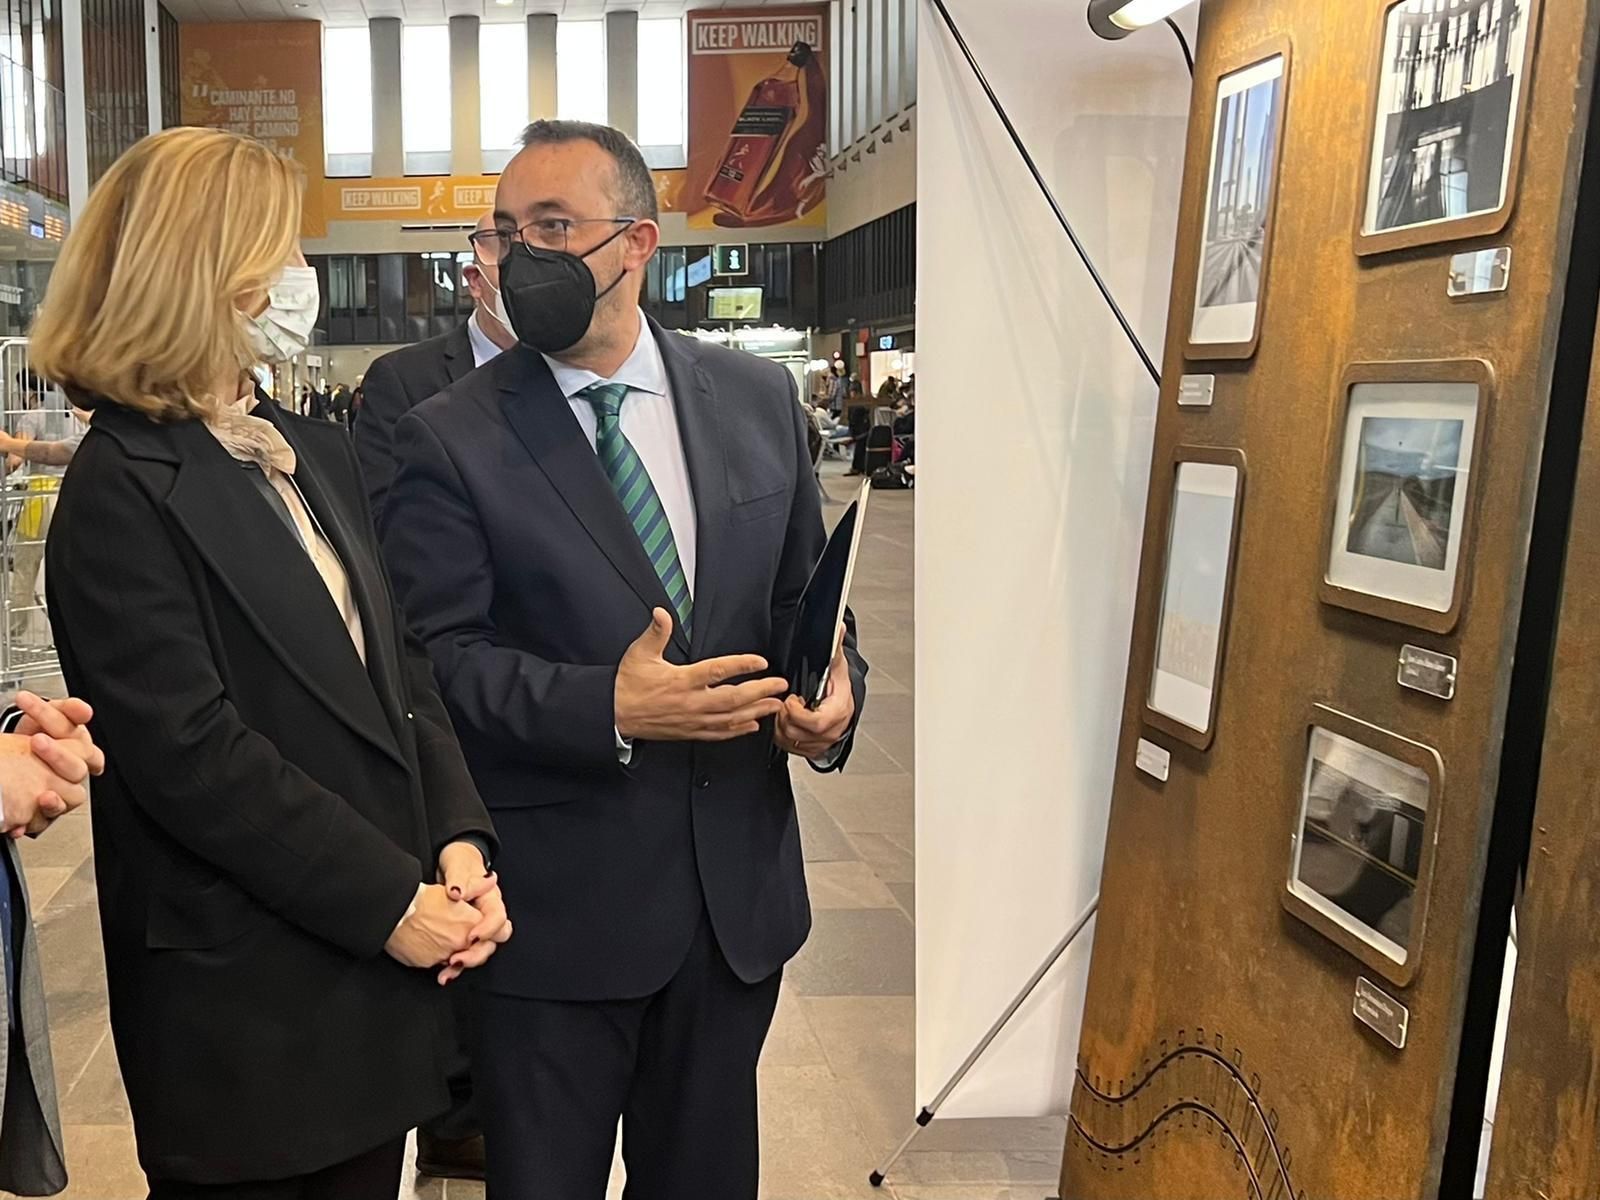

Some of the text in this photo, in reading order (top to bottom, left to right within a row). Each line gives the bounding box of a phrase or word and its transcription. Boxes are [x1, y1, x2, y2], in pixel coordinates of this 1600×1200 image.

[698, 22, 816, 49] KEEP WALKING
[280, 89, 296, 105] NO
[229, 106, 250, 122] HAY
[254, 122, 299, 137] CAMINO
[343, 189, 418, 205] KEEP WALKING
[456, 188, 479, 204] KEEP
